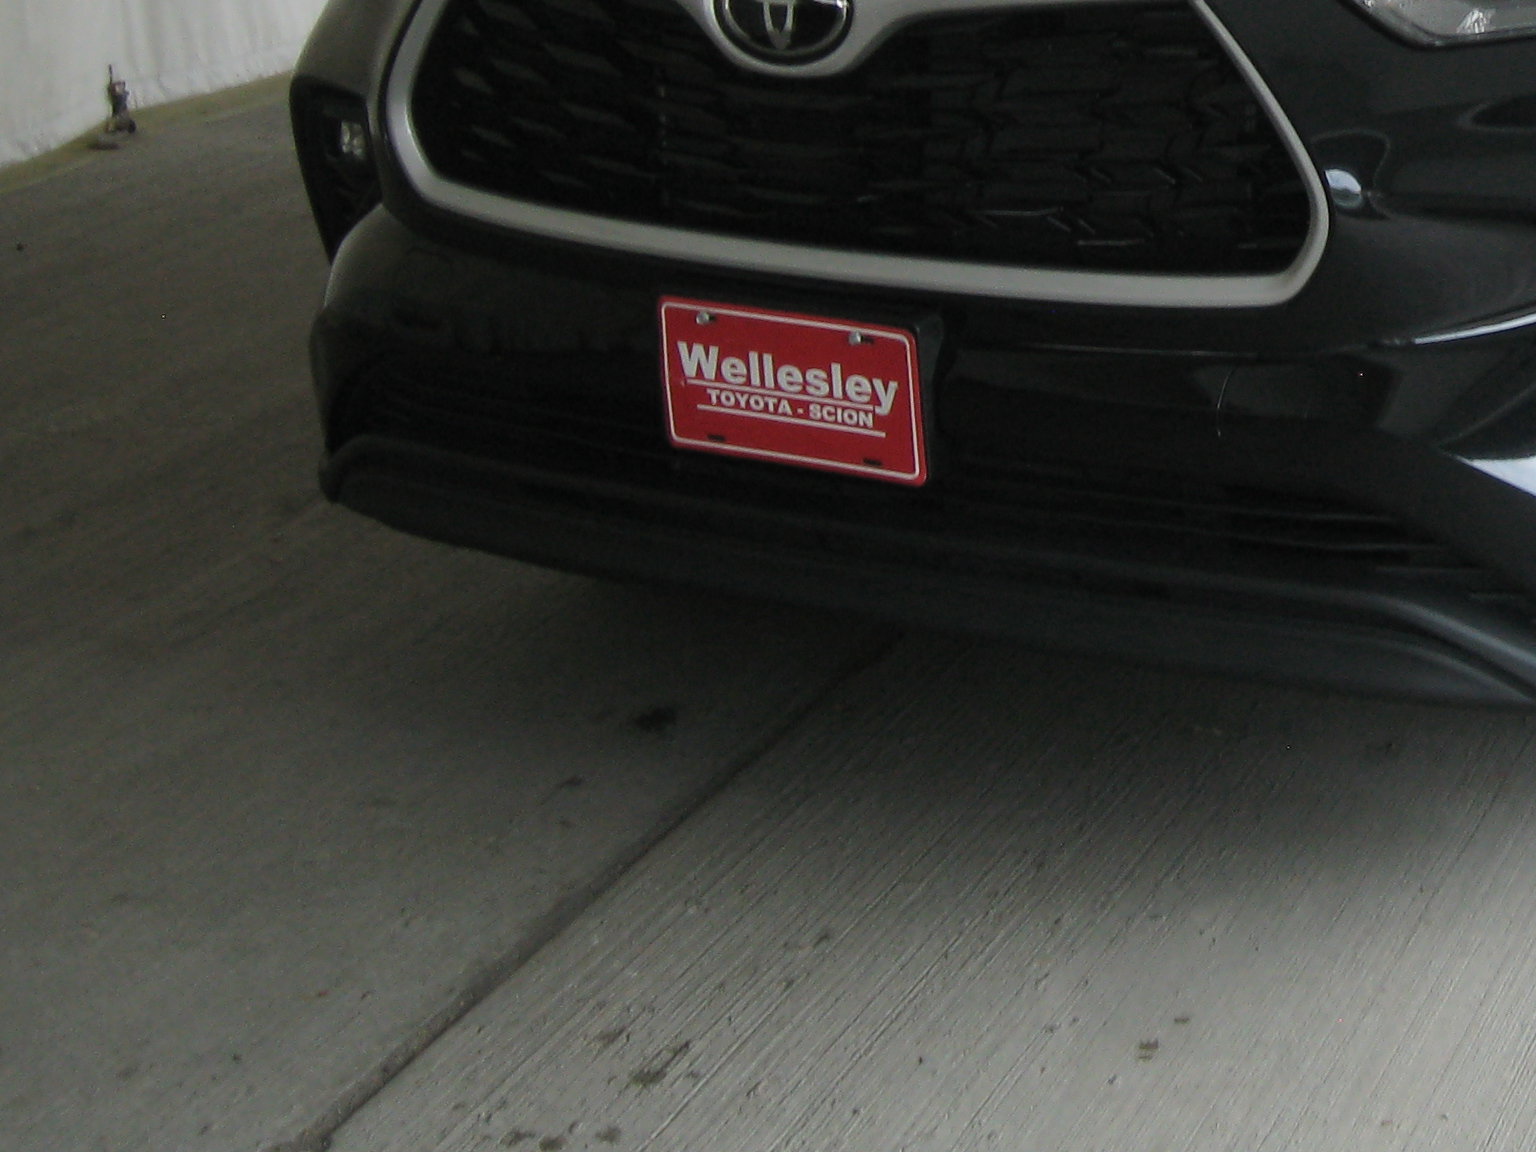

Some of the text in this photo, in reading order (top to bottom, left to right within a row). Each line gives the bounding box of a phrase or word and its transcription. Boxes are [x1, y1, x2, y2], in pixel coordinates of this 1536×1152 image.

[677, 341, 898, 416] Wellesley
[707, 388, 793, 416] TOYOTA
[809, 403, 874, 428] SCION
